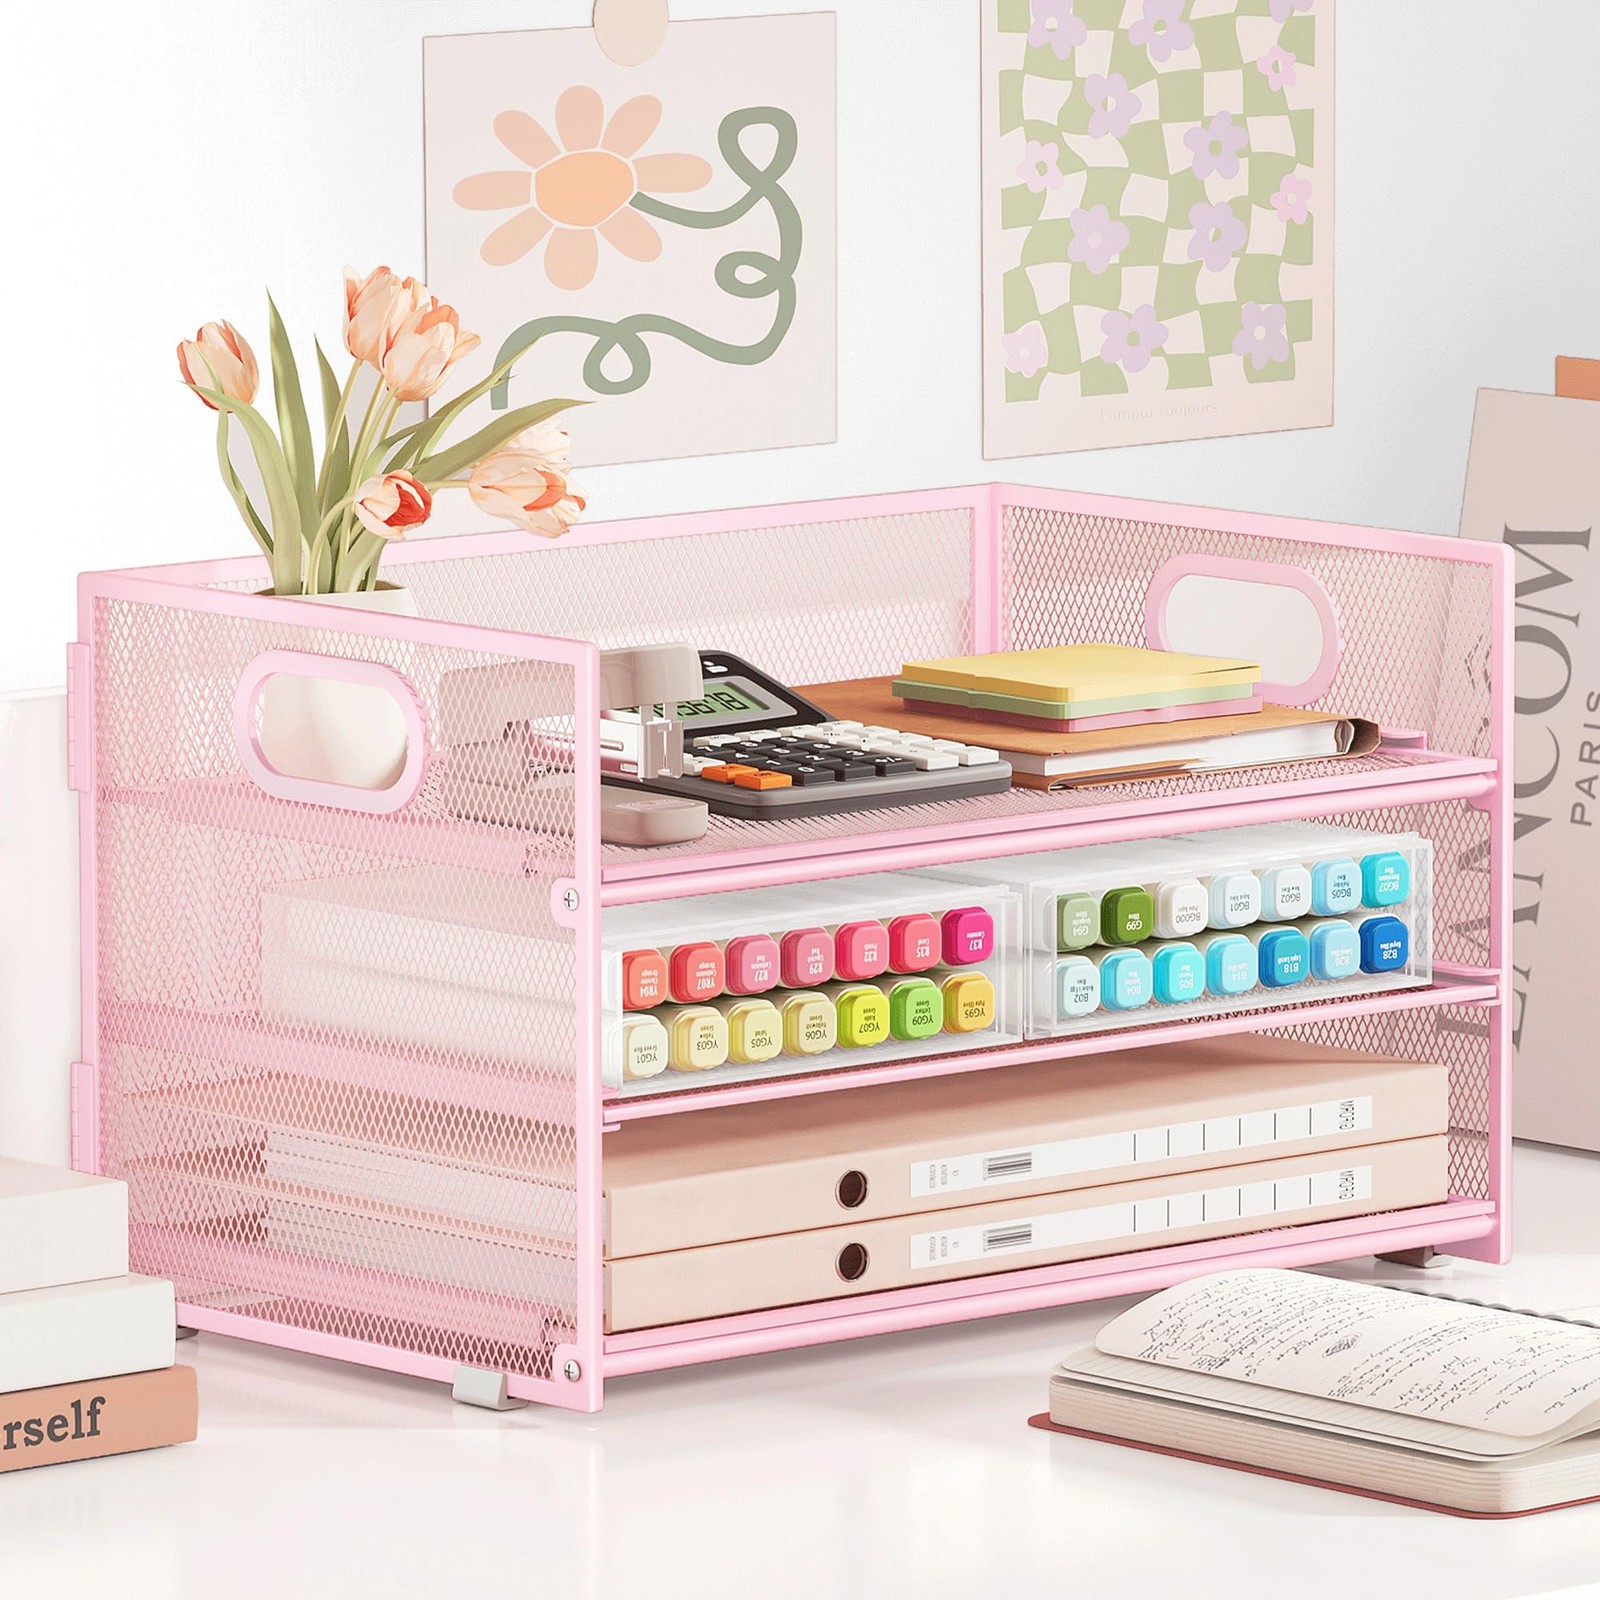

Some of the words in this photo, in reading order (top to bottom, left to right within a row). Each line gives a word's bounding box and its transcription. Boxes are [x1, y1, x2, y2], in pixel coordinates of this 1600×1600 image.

[1379, 881, 1399, 892] BG07
[1280, 893, 1300, 903] BG02
[1331, 888, 1351, 899] BG05
[1230, 901, 1250, 912] BG01
[1176, 912, 1201, 924] BG000
[1073, 925, 1088, 936] G94
[1125, 921, 1142, 931] G99
[969, 938, 982, 950] R37
[864, 950, 877, 962] R32
[916, 946, 930, 958] R35
[1383, 949, 1397, 959] B28
[698, 962, 715, 970] Orange
[1335, 957, 1349, 966] B26
[809, 963, 823, 974] R29
[1284, 963, 1299, 973] B18
[755, 970, 768, 981] R27
[697, 977, 715, 989] YR07
[1178, 979, 1193, 989] B05
[640, 985, 658, 997] YR04
[1126, 986, 1141, 995] B04
[1074, 993, 1089, 1003] B02
[863, 1007, 876, 1015] Green
[964, 1008, 985, 1018] YG95
[912, 1015, 933, 1025] YG09
[859, 1022, 880, 1033] YG07
[805, 1030, 827, 1040] YG06
[697, 1040, 718, 1051] YG03
[751, 1037, 772, 1048] YG05
[636, 1053, 657, 1063] YG01
